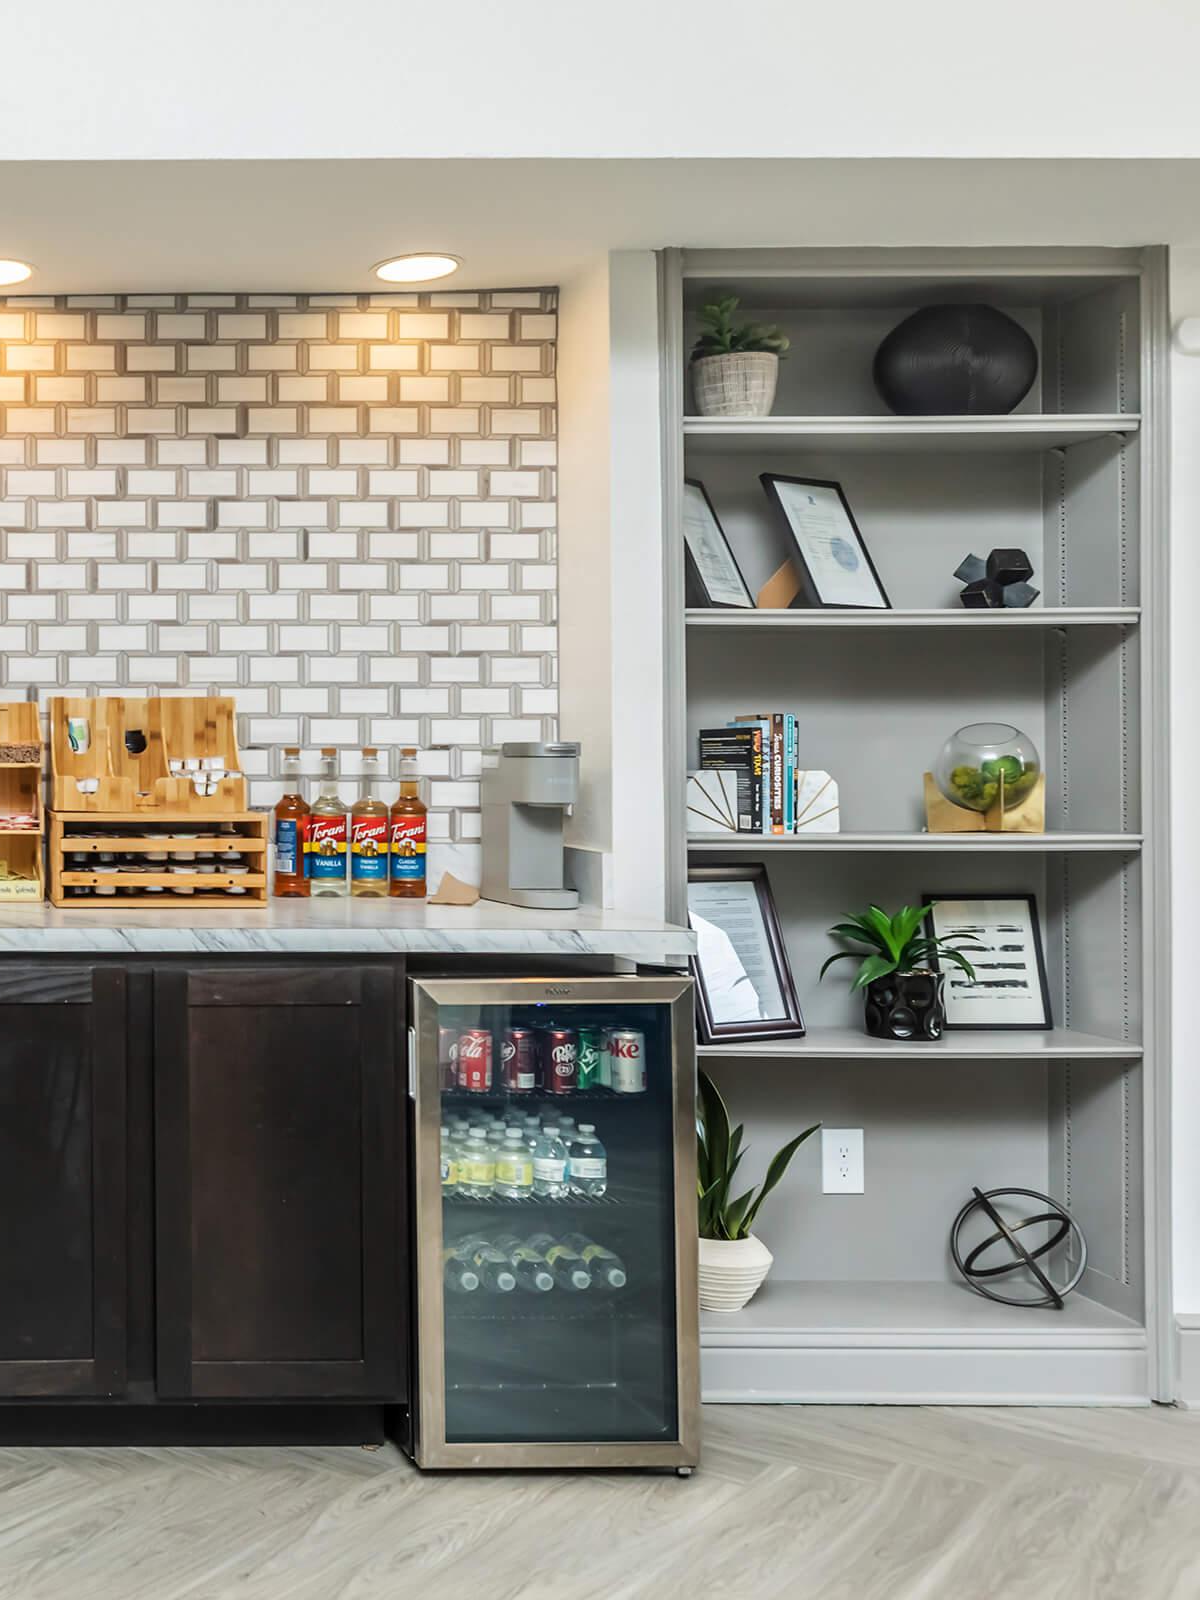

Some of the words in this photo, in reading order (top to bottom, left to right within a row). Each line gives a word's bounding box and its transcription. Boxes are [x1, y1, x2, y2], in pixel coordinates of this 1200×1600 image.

[312, 821, 346, 843] Torani
[352, 821, 387, 844] Torani
[391, 821, 426, 844] Torani
[315, 858, 342, 867] VANILLA
